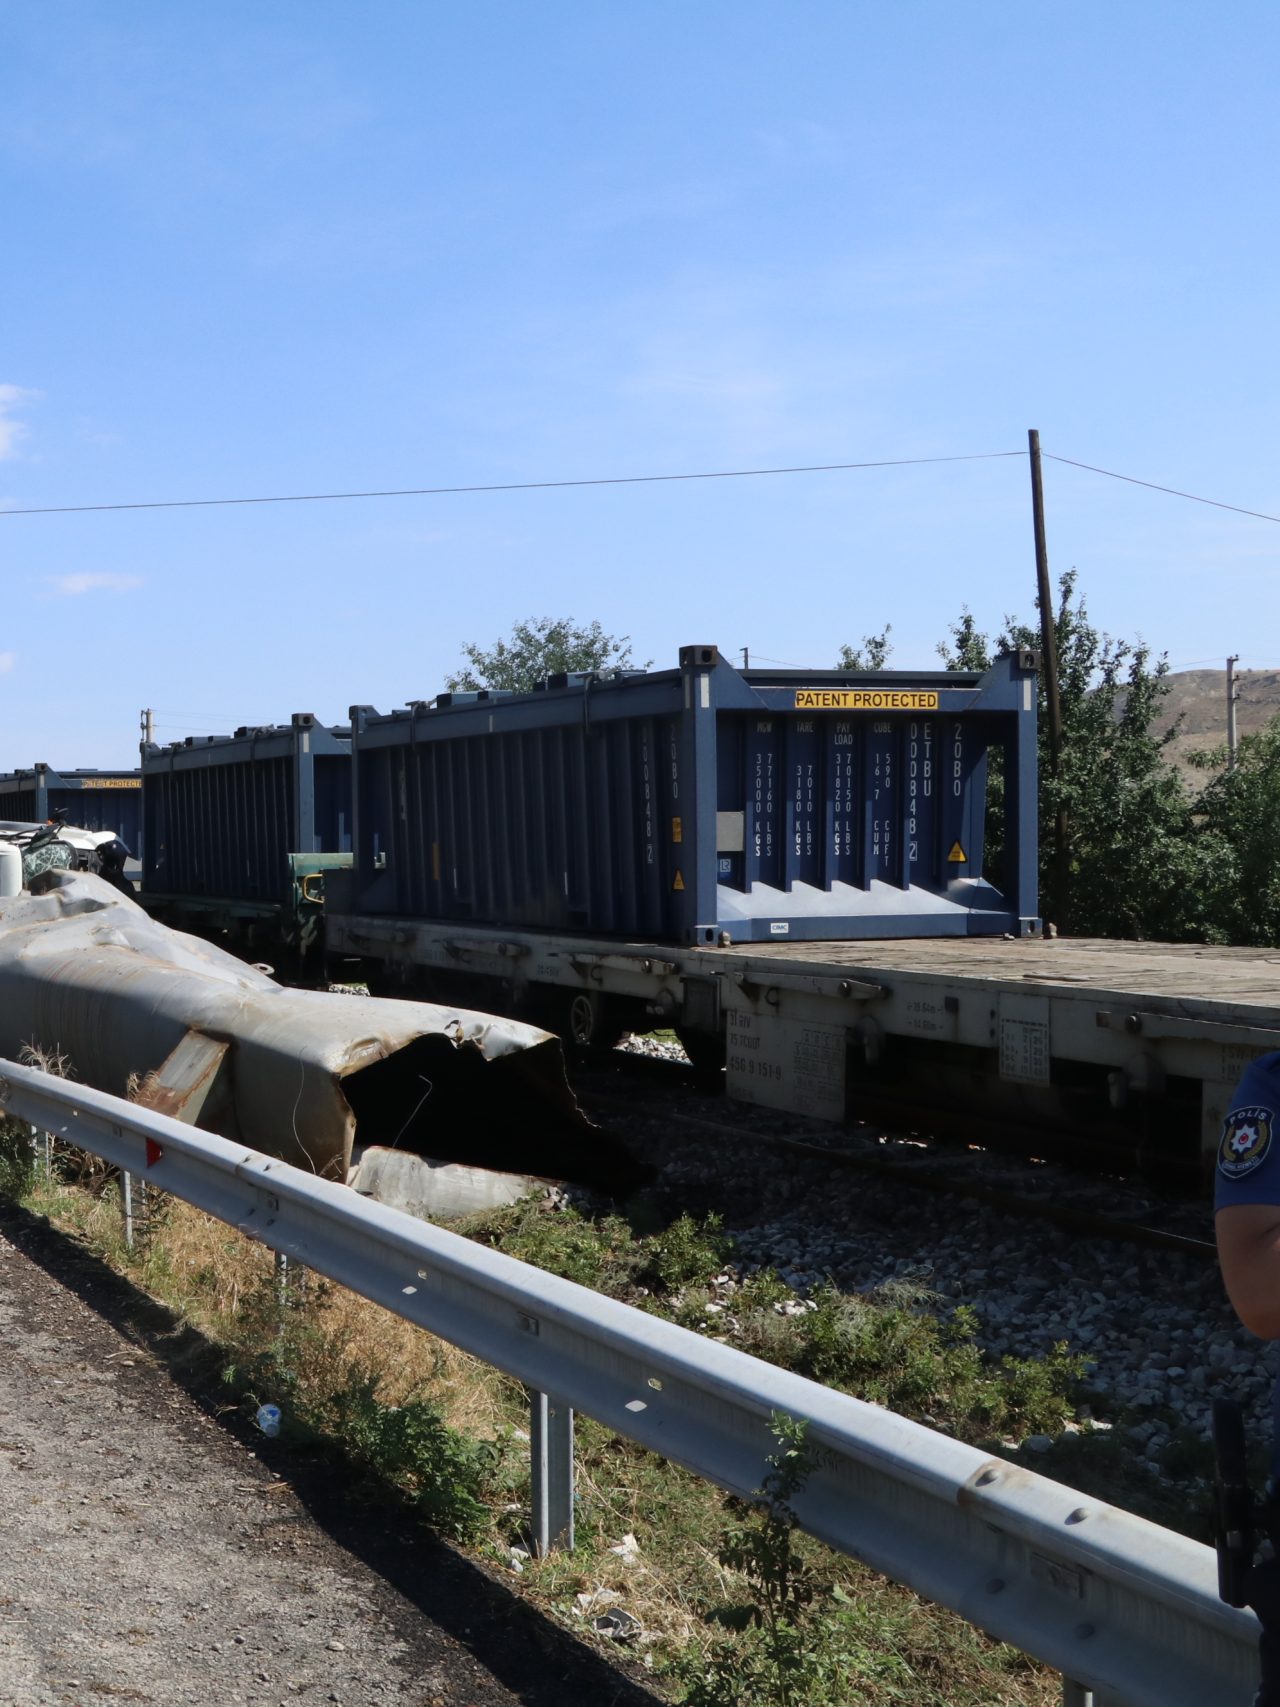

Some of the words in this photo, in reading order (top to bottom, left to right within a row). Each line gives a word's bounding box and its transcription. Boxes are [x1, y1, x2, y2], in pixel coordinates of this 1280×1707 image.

[796, 692, 849, 706] PATENT
[853, 693, 937, 707] PROTECTED
[833, 733, 854, 745] LOAD
[1229, 1108, 1268, 1125] POLİS
